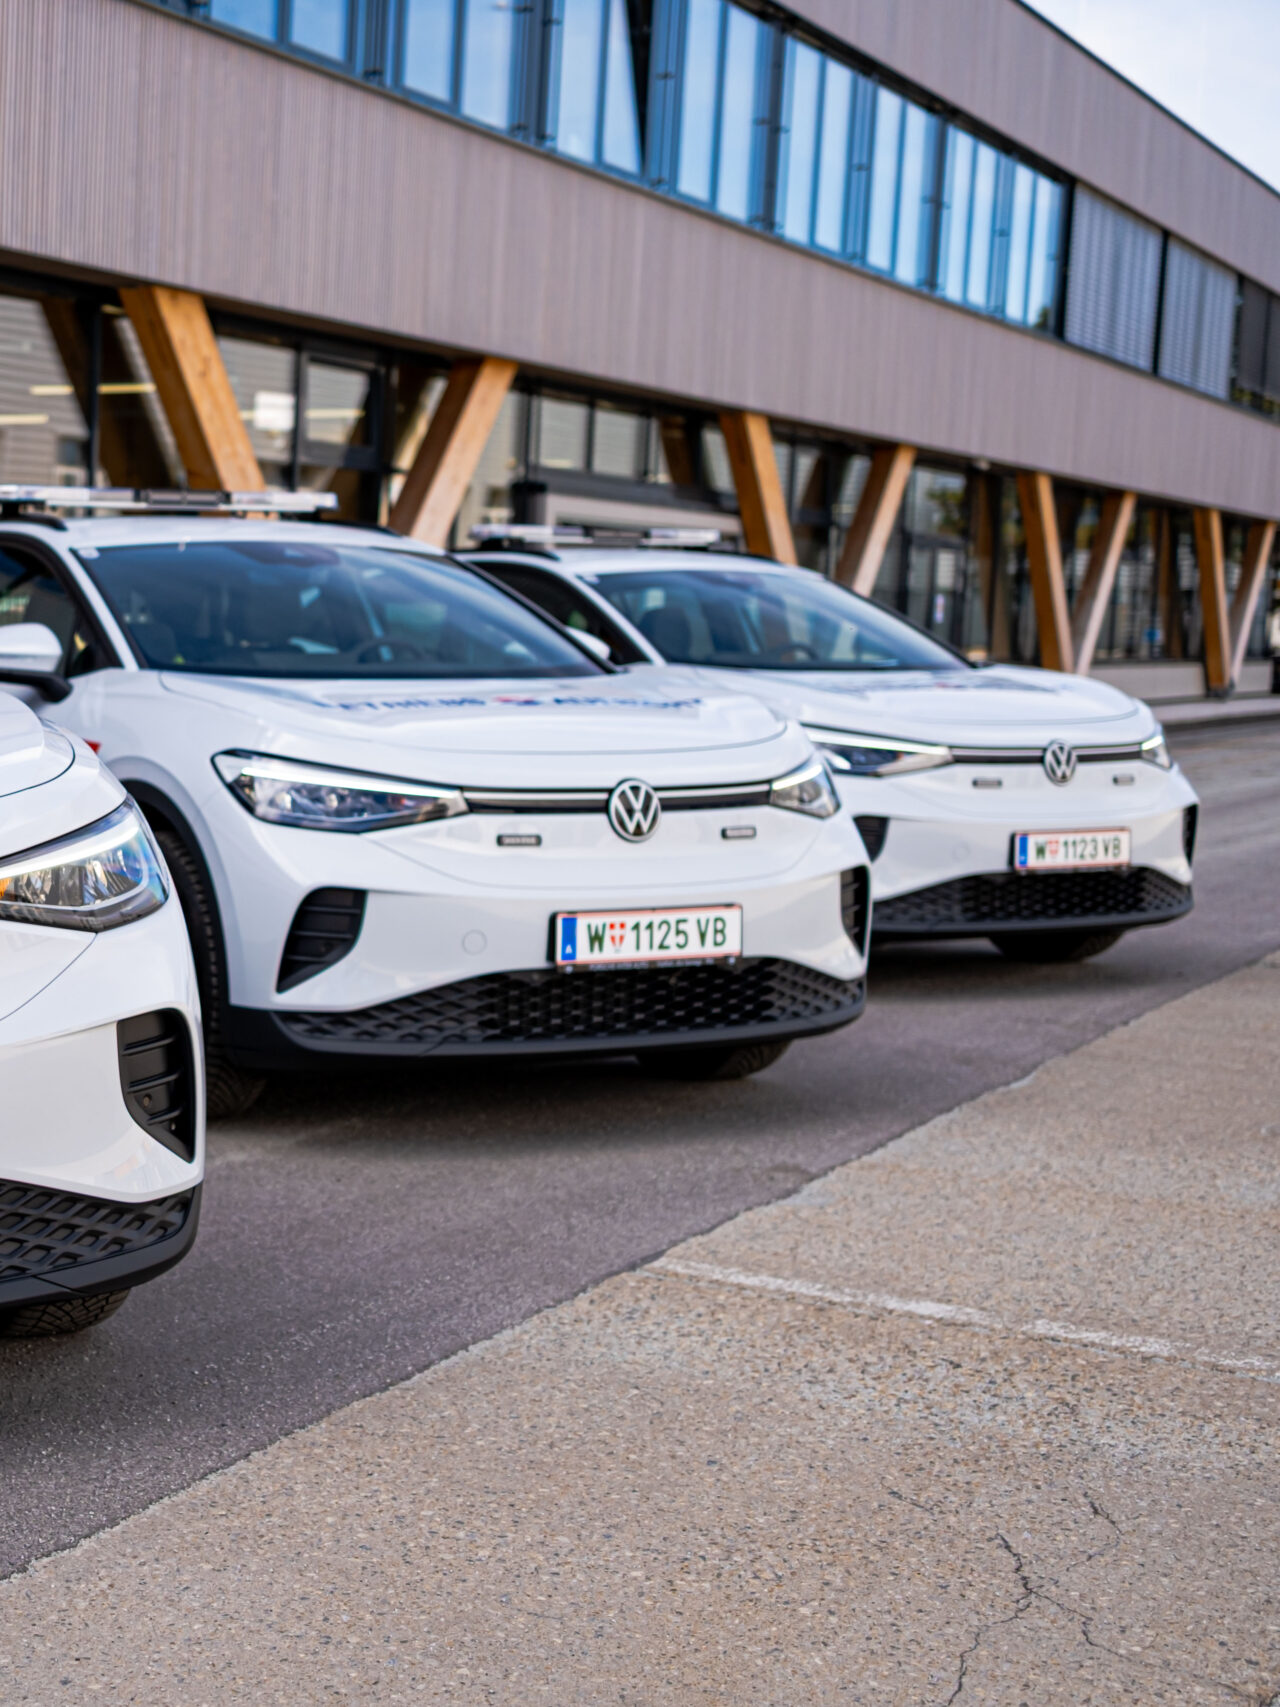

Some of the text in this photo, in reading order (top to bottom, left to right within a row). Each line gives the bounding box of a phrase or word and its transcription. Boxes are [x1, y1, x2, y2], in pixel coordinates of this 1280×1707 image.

[609, 778, 661, 842] VW
[1062, 837, 1098, 860] 1123
[1102, 836, 1122, 858] VB
[587, 916, 727, 954] W 1125 VB
